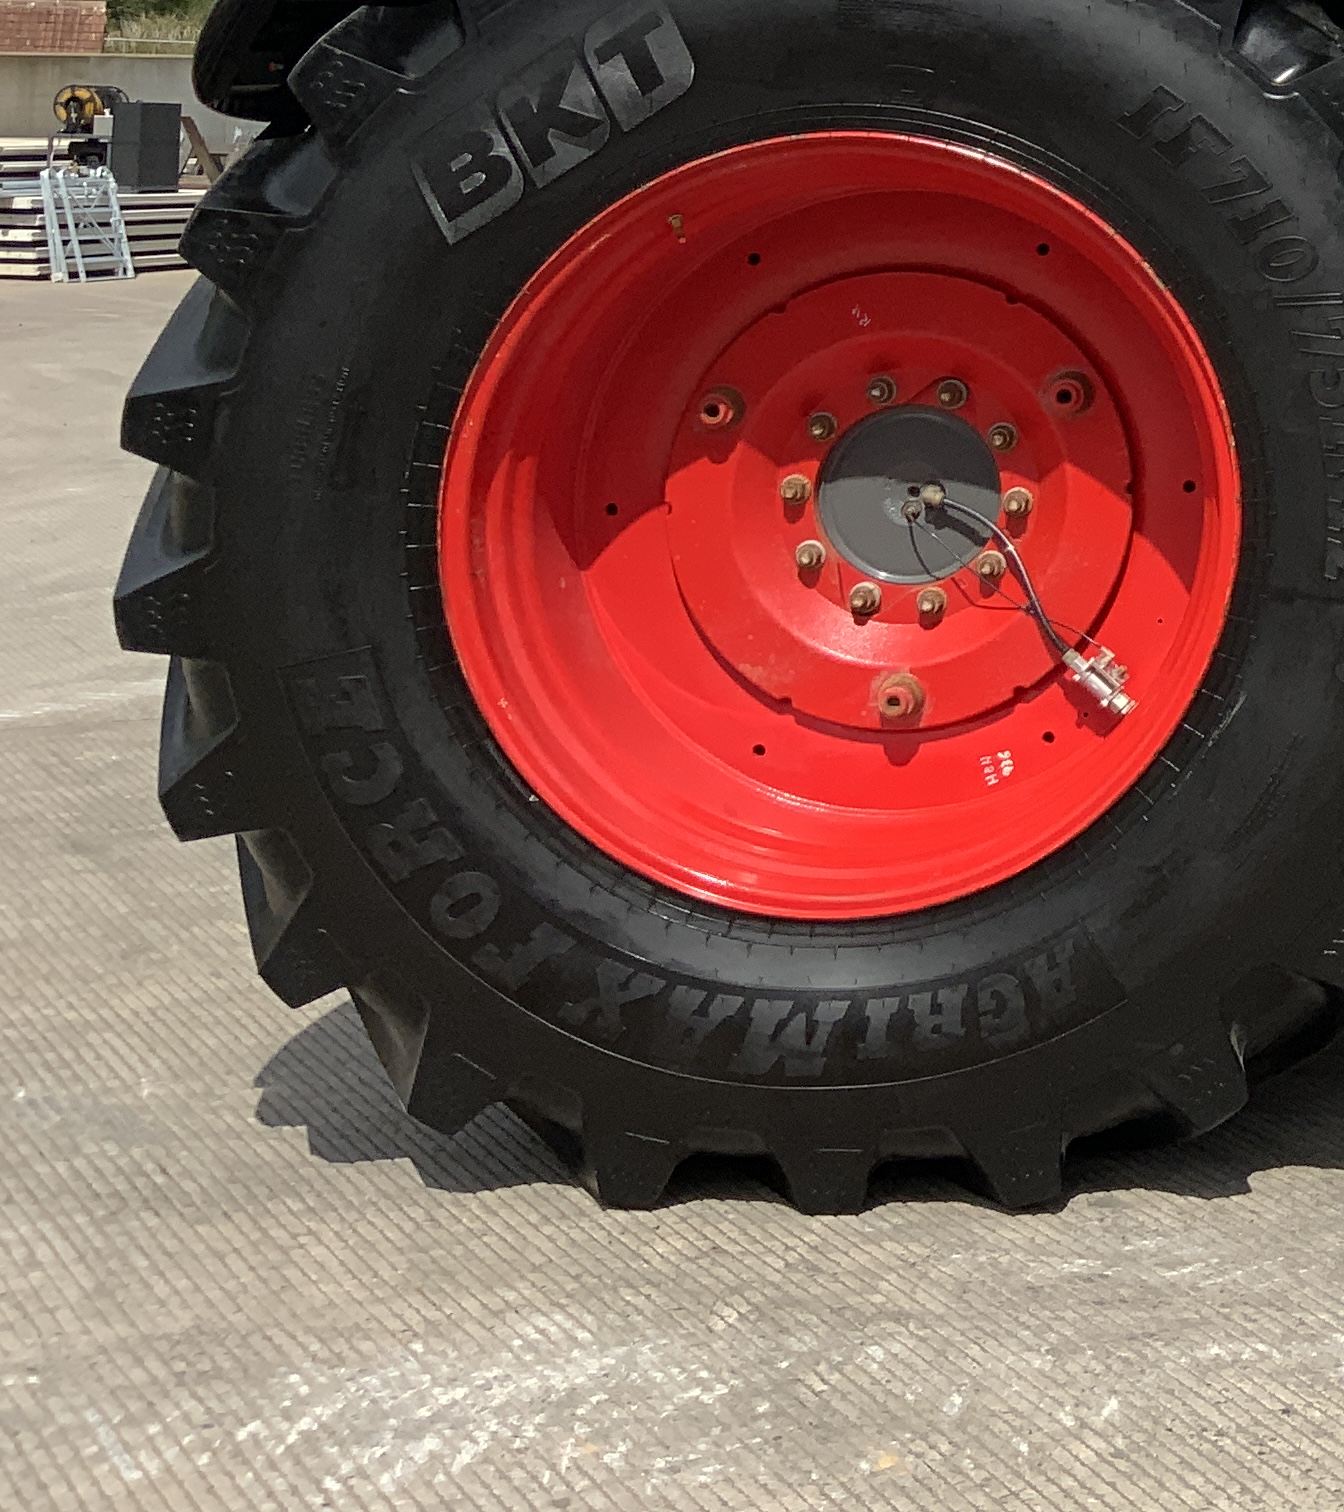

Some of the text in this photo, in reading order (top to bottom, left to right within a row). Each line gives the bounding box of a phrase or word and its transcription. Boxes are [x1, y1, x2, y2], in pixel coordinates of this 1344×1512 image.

[420, 0, 680, 236] BKT
[292, 674, 1078, 1078] AGRIMAX FORCE
